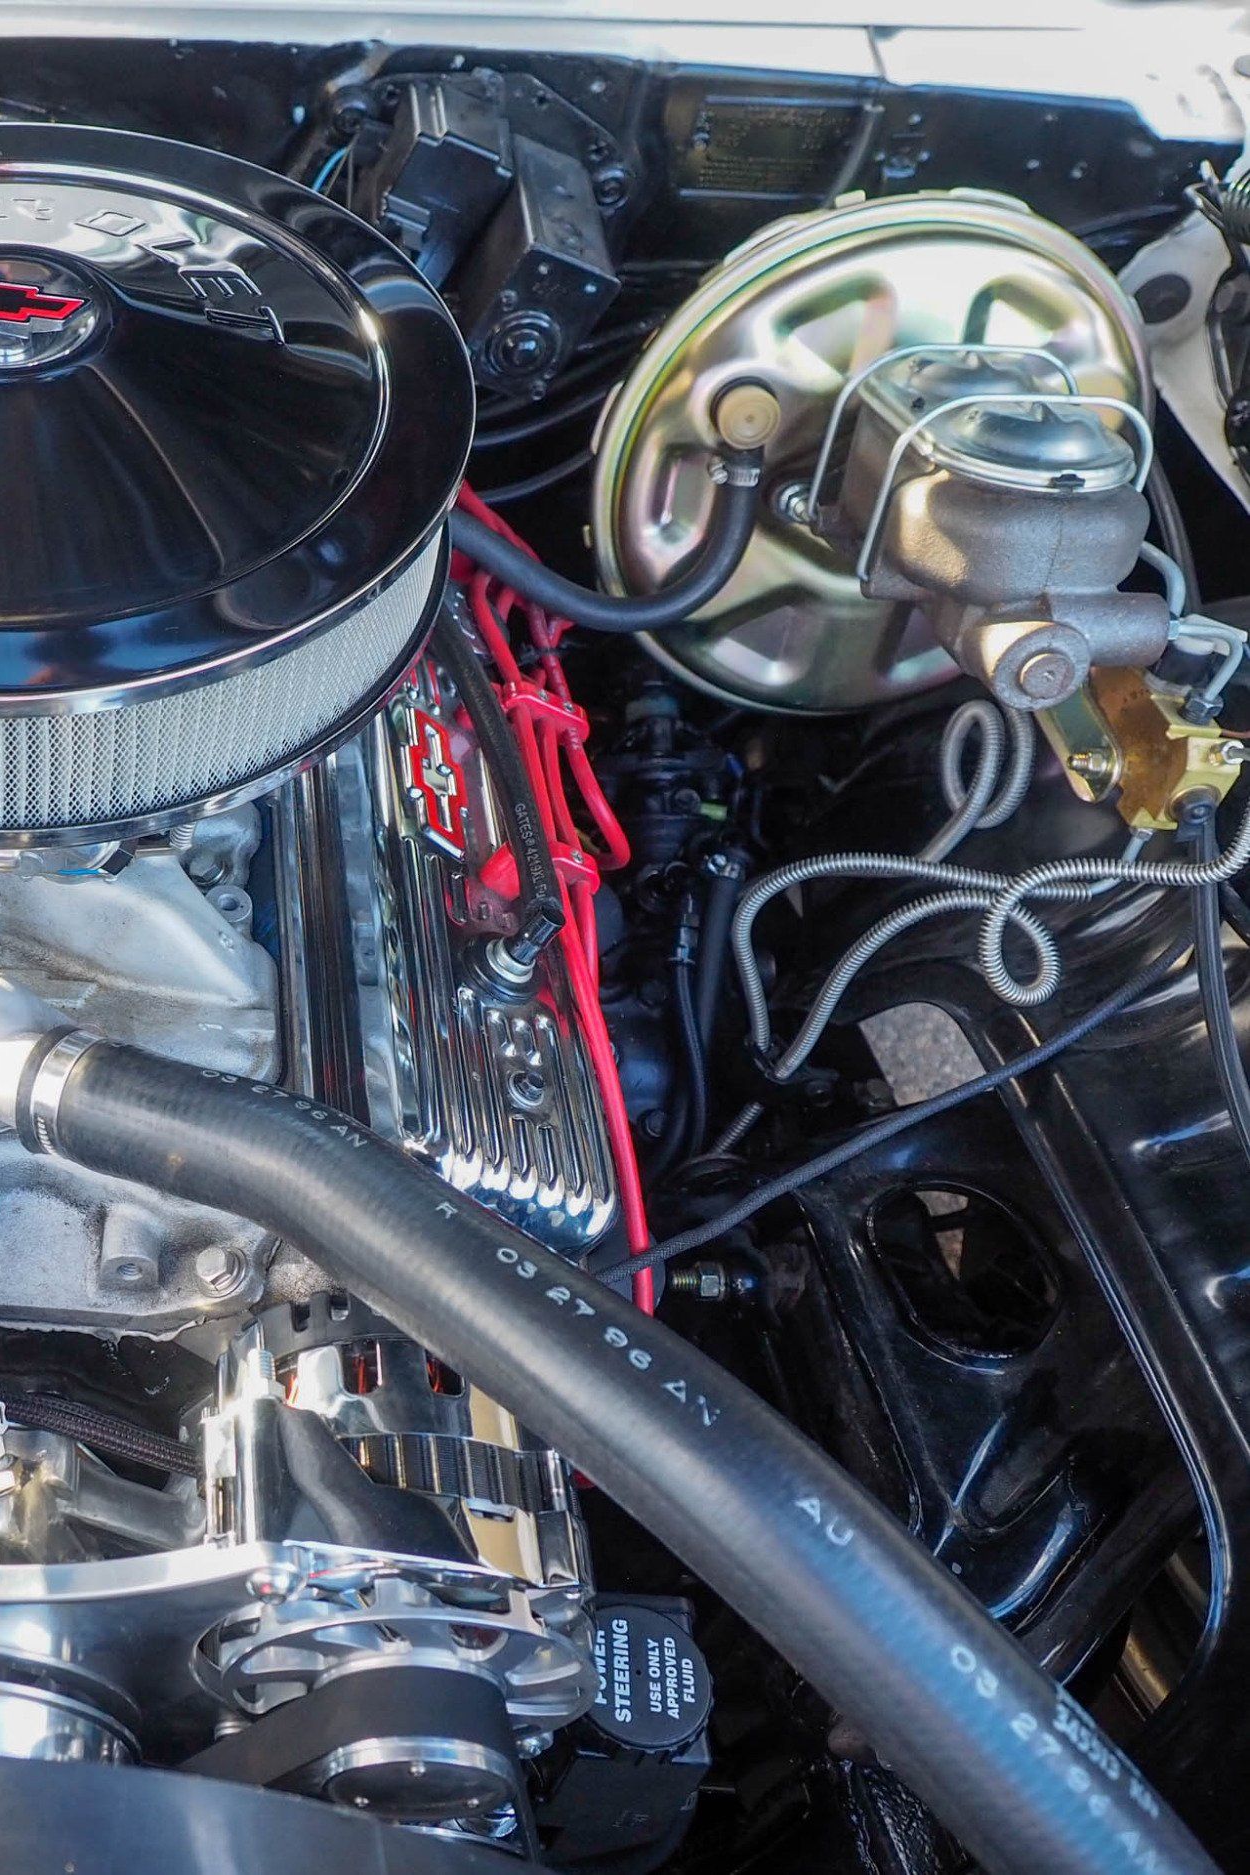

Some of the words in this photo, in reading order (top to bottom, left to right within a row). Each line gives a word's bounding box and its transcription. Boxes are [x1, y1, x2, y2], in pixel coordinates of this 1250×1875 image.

[496, 1248, 538, 1280] 03
[546, 1286, 596, 1317] 27
[612, 1619, 632, 1723] STEERING
[647, 1638, 661, 1679] ONLY
[664, 1637, 680, 1719] APPROVED
[681, 1658, 696, 1704] FLUID
[650, 1682, 662, 1713] USE
